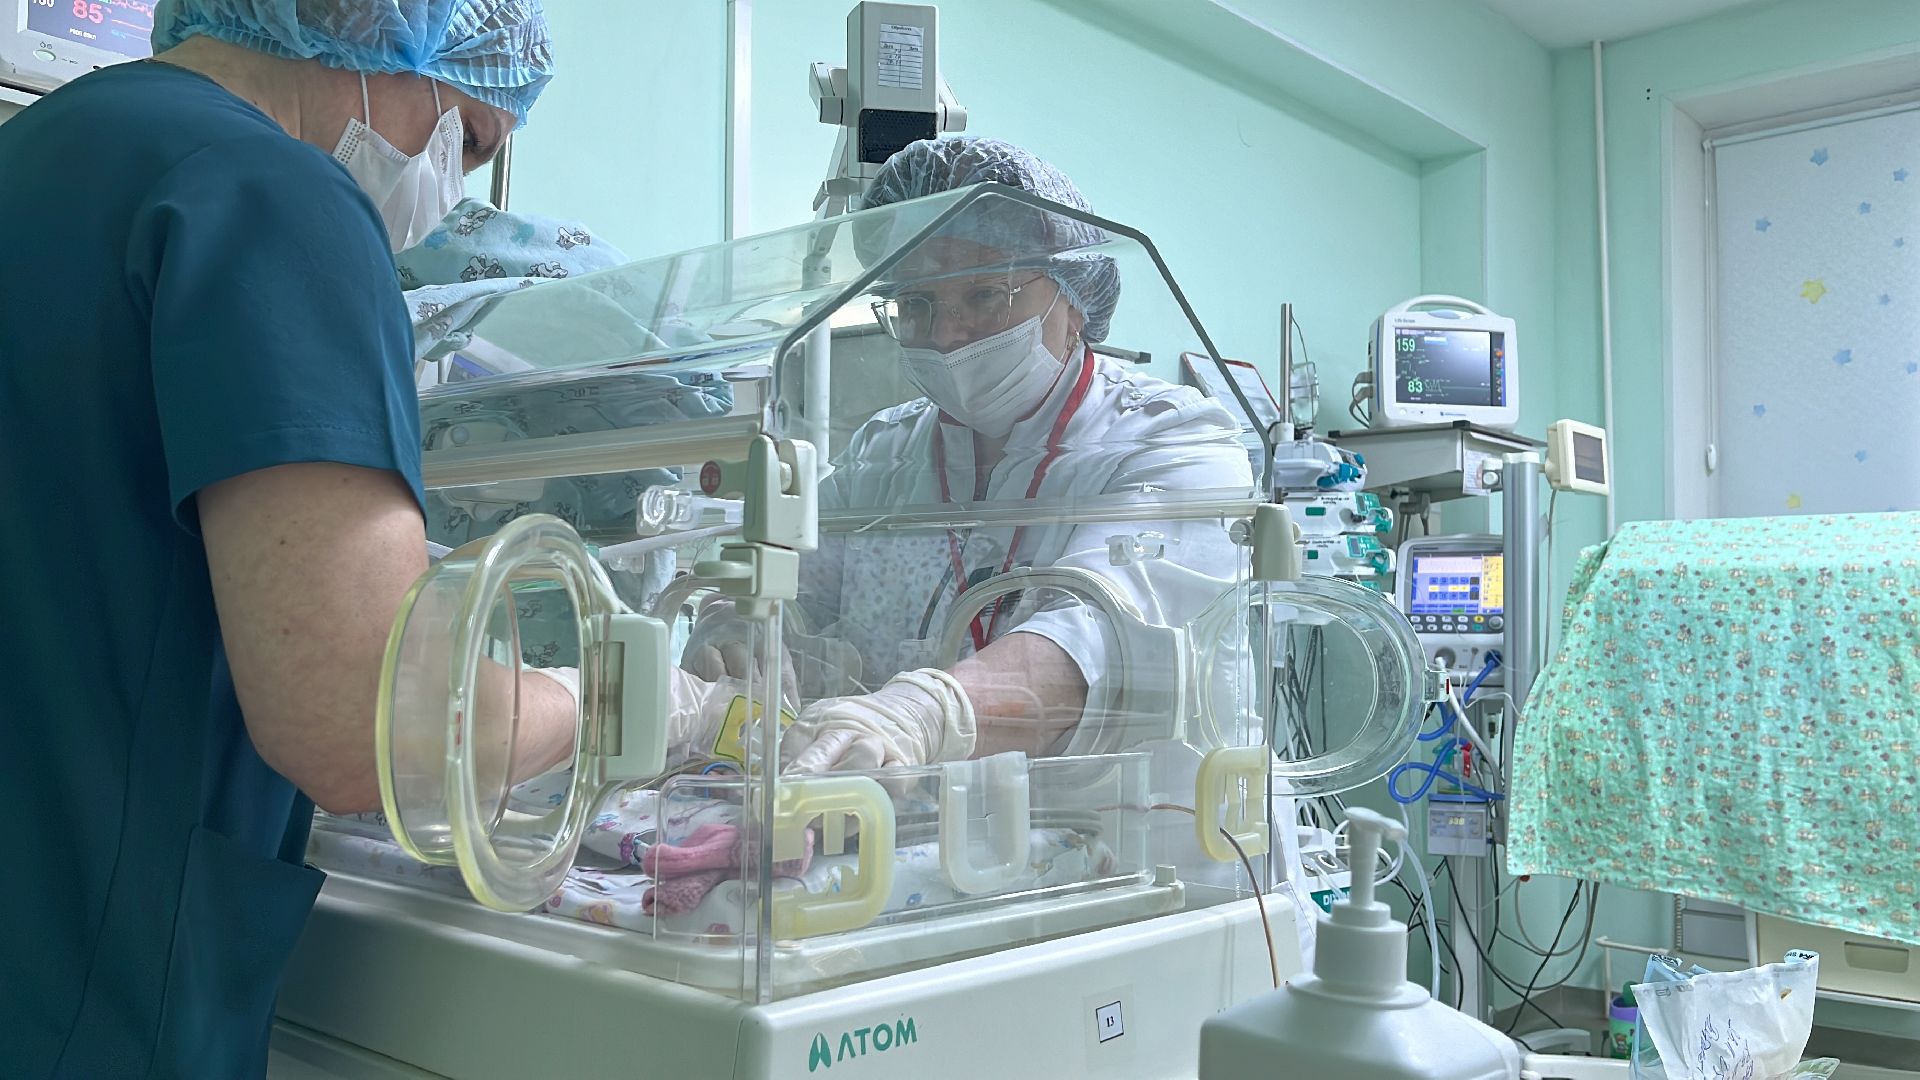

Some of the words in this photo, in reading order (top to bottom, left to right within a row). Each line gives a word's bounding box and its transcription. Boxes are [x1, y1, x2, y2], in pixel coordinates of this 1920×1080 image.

[73, 0, 104, 24] 85
[1396, 337, 1416, 352] 159
[1407, 380, 1423, 393] 83
[1106, 1015, 1115, 1028] 13
[837, 1017, 918, 1062] ATOM
